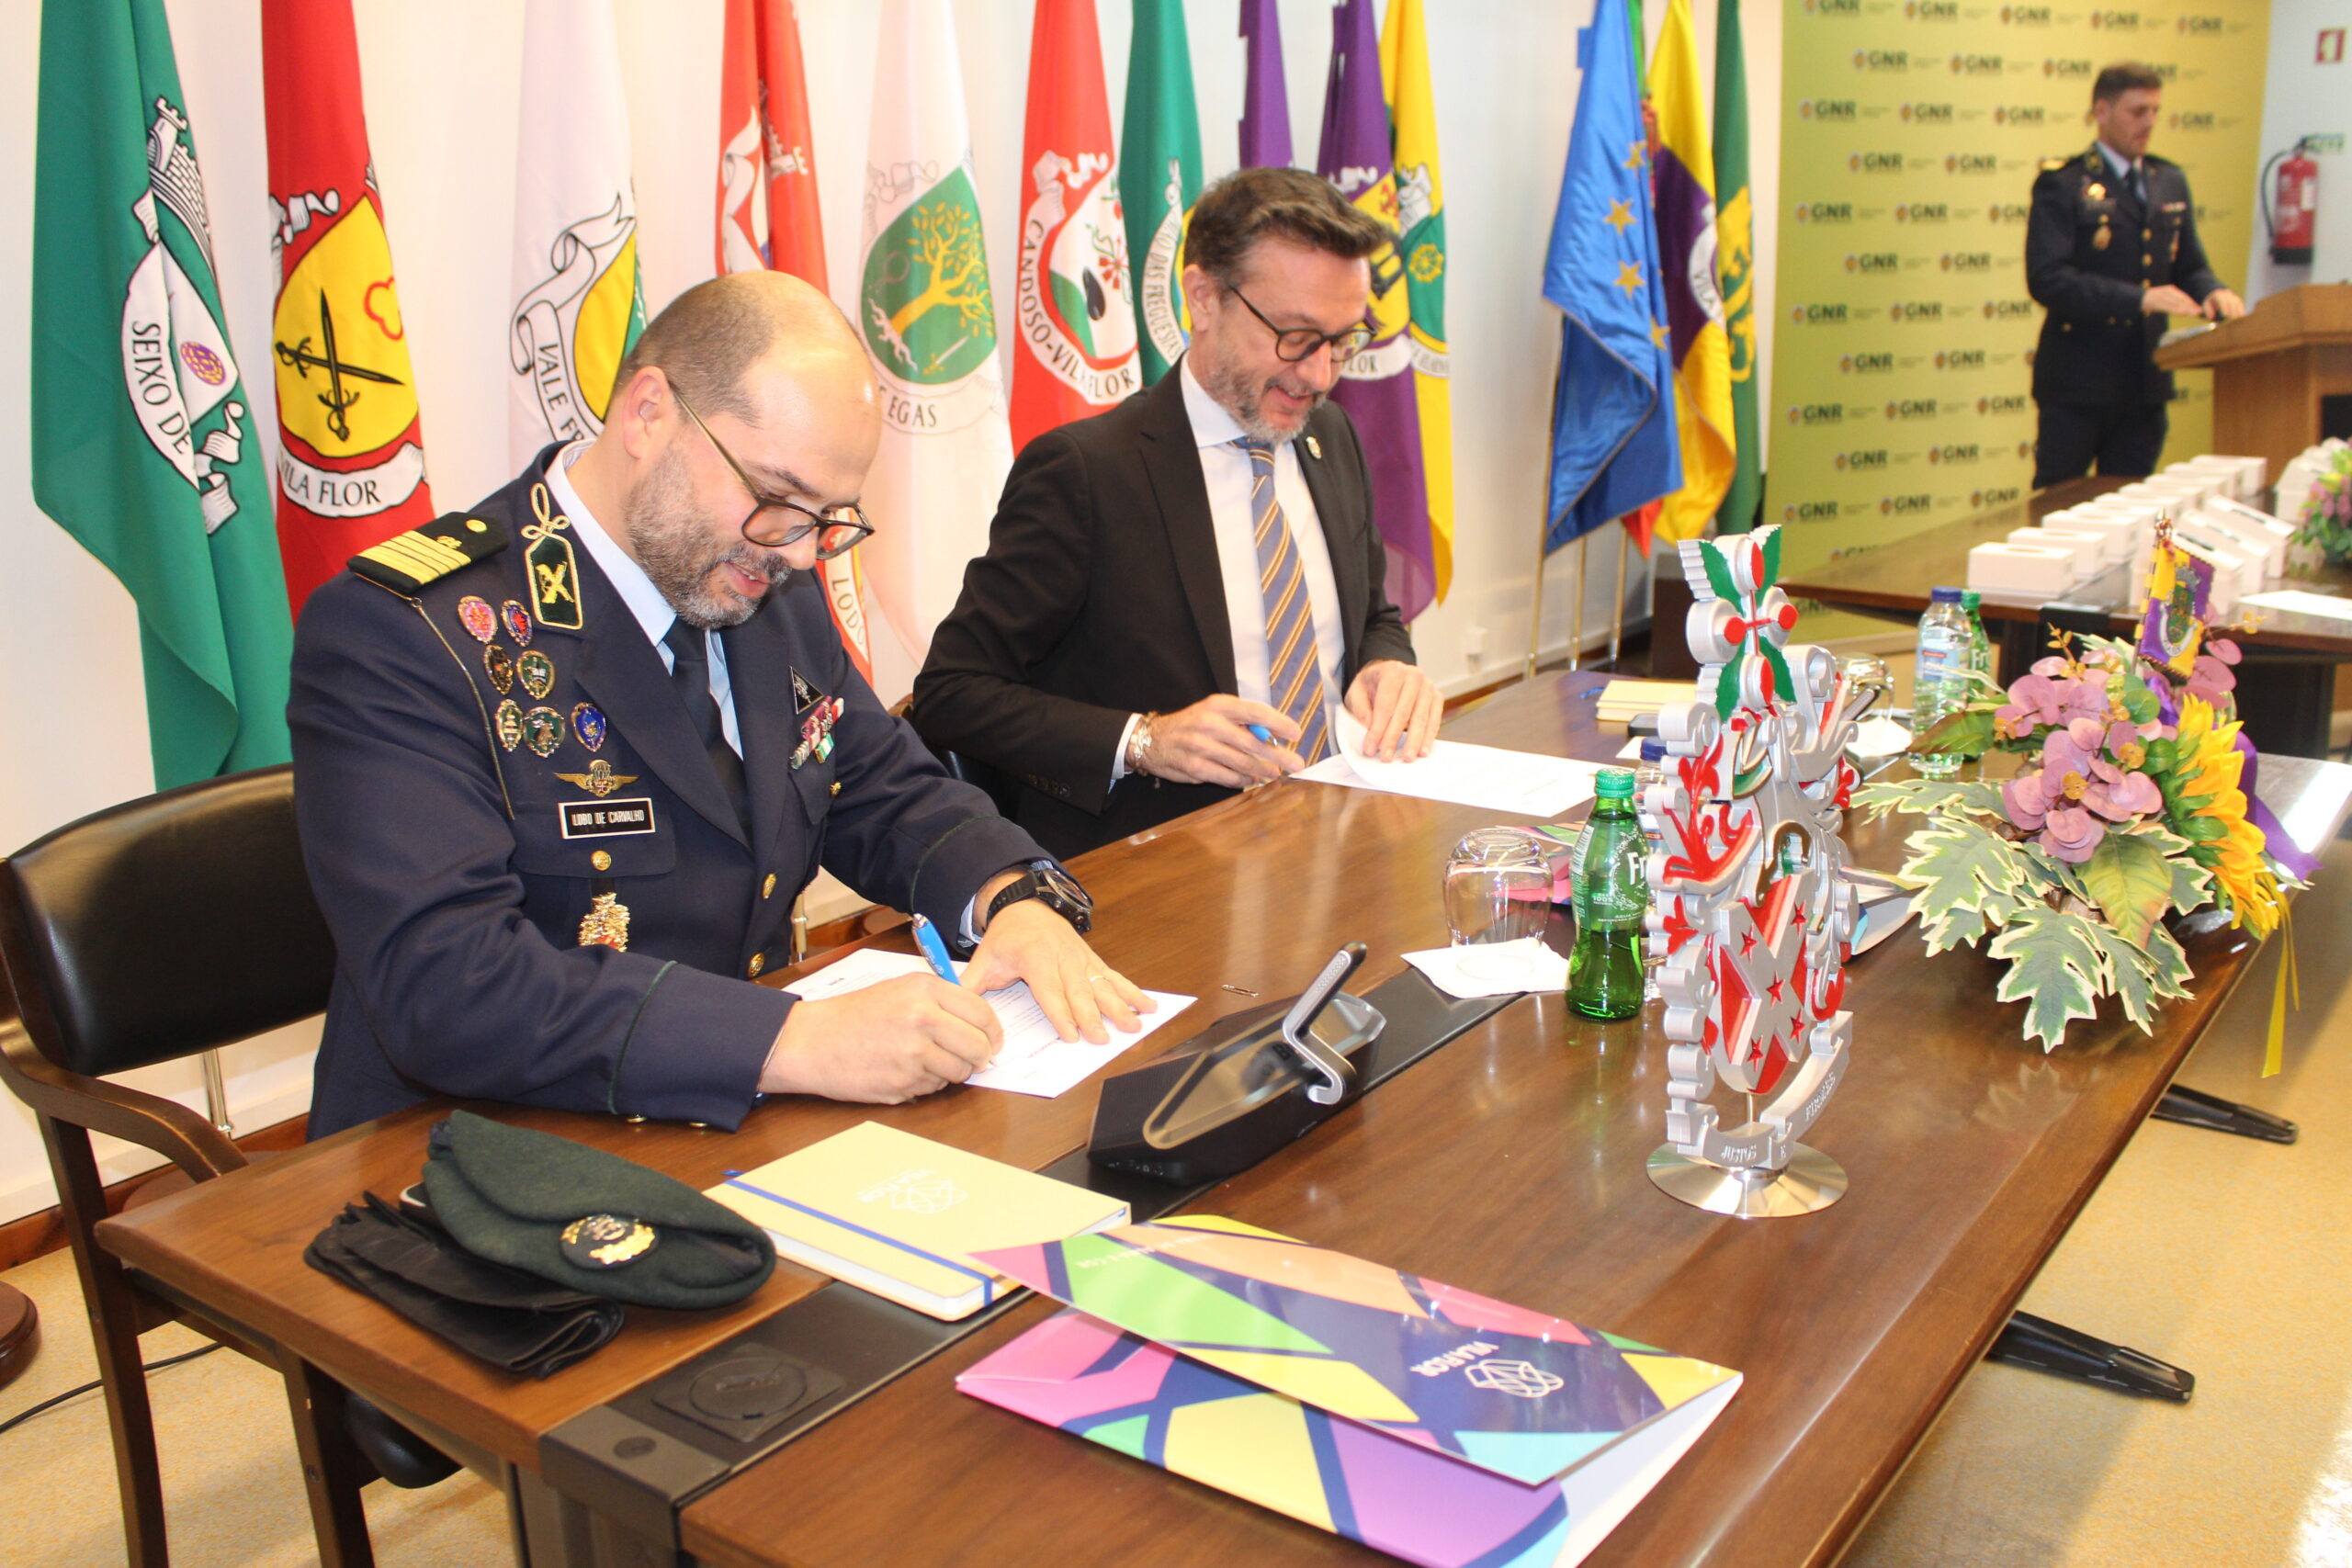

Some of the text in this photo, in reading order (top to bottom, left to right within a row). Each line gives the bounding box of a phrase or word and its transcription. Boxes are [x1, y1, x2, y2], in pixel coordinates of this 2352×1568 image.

[1920, 2, 1958, 17] GNR
[2015, 6, 2050, 21] GNR
[2104, 12, 2139, 27] GNR
[2189, 17, 2222, 31] GNR
[1868, 51, 1908, 67] GNR
[1965, 55, 2002, 70] GNR
[2056, 61, 2091, 74] GNR
[1815, 100, 1856, 117] GNR
[1914, 104, 1952, 119] GNR
[2008, 107, 2044, 121] GNR
[2181, 113, 2213, 127] GNR
[1864, 153, 1904, 169] GNR
[1960, 154, 1996, 169] GNR
[1811, 203, 1852, 219] GNR
[1910, 204, 1948, 219] GNR
[2003, 205, 2029, 219] GN
[1860, 254, 1898, 269] GNR
[1954, 254, 1991, 267] GNR
[1807, 304, 1848, 320] GNR
[1905, 302, 1942, 317] GNR
[1997, 300, 2031, 315] GNR
[1342, 353, 1377, 373] LOR
[1855, 353, 1894, 369] GNR
[1949, 351, 1984, 365] GNR
[537, 343, 568, 411] VALE
[132, 321, 190, 455] SEIXO DE
[888, 394, 936, 427] EGAS
[1900, 400, 1937, 415] GNR
[1992, 396, 2025, 411] GNR
[1804, 404, 1843, 421] GNR
[1850, 450, 1888, 467] GNR
[1943, 446, 1979, 459] GNR
[318, 479, 381, 507] FLOR
[1985, 489, 2018, 503] GNR
[1799, 502, 1838, 518] GNR
[1894, 495, 1931, 511] GNR
[571, 809, 645, 826] LOBO DE CARVALHO
[1627, 851, 1647, 886] Fr
